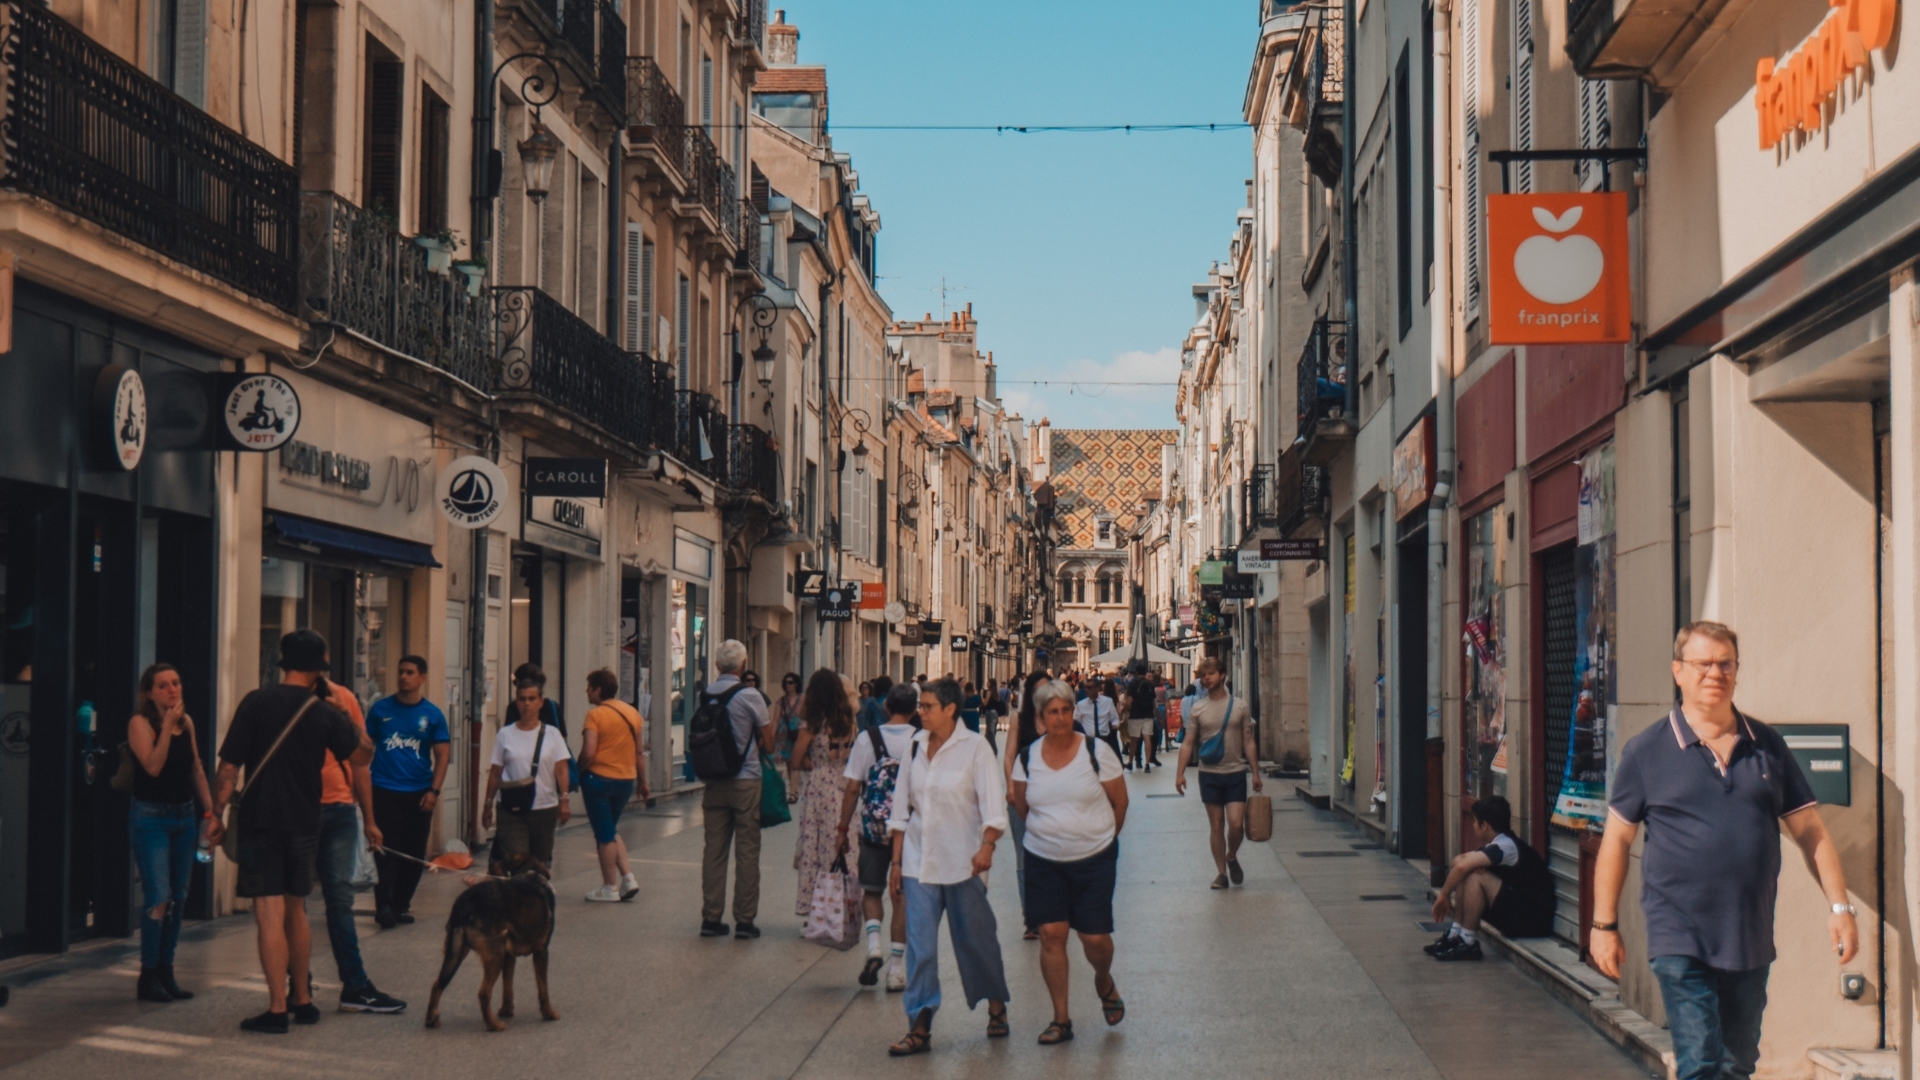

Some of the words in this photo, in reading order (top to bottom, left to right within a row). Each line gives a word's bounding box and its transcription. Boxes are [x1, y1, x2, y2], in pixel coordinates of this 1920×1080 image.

[1518, 308, 1600, 328] franprix
[229, 392, 242, 416] Just
[241, 379, 266, 392] Over
[270, 379, 287, 396] The
[246, 434, 276, 443] JOTT
[535, 470, 597, 484] CAROLL
[442, 497, 463, 521] PETIT
[467, 500, 499, 523] BATEAU
[1264, 542, 1299, 550] COMPTOIR
[821, 609, 849, 618] FAGUO
